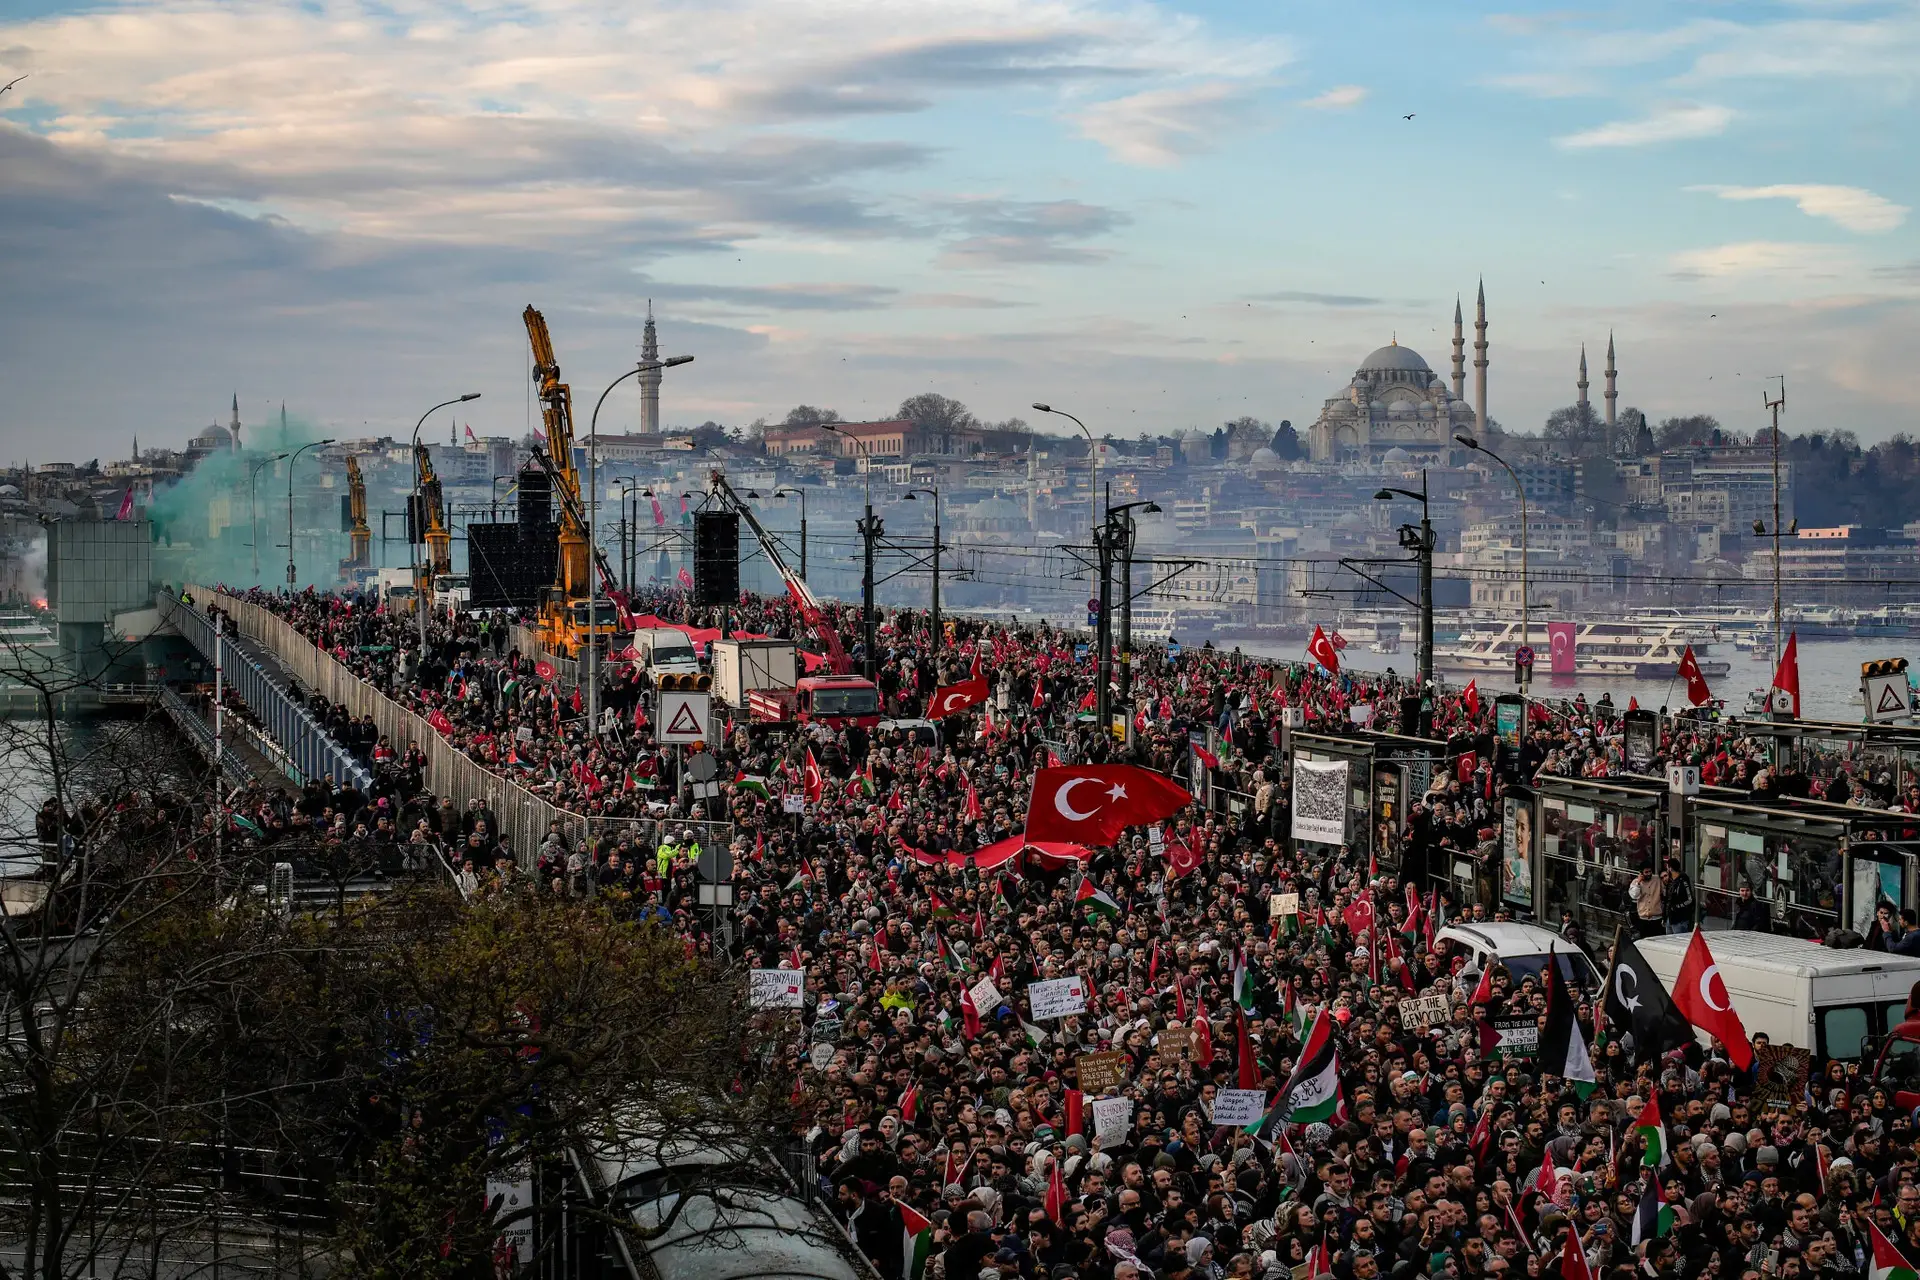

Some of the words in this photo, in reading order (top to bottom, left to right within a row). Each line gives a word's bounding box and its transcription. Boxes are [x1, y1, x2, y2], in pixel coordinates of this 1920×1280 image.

[1401, 1000, 1421, 1013] STOP
[1424, 997, 1441, 1009] THE
[1403, 1008, 1447, 1027] GENOCIDE
[1507, 1029, 1514, 1037] TO
[1507, 1036, 1536, 1045] PALESTINE
[1523, 1044, 1537, 1052] FREE
[1080, 1057, 1096, 1067] from
[1081, 1070, 1114, 1081] PALESTINE
[1100, 1077, 1115, 1085] FREE
